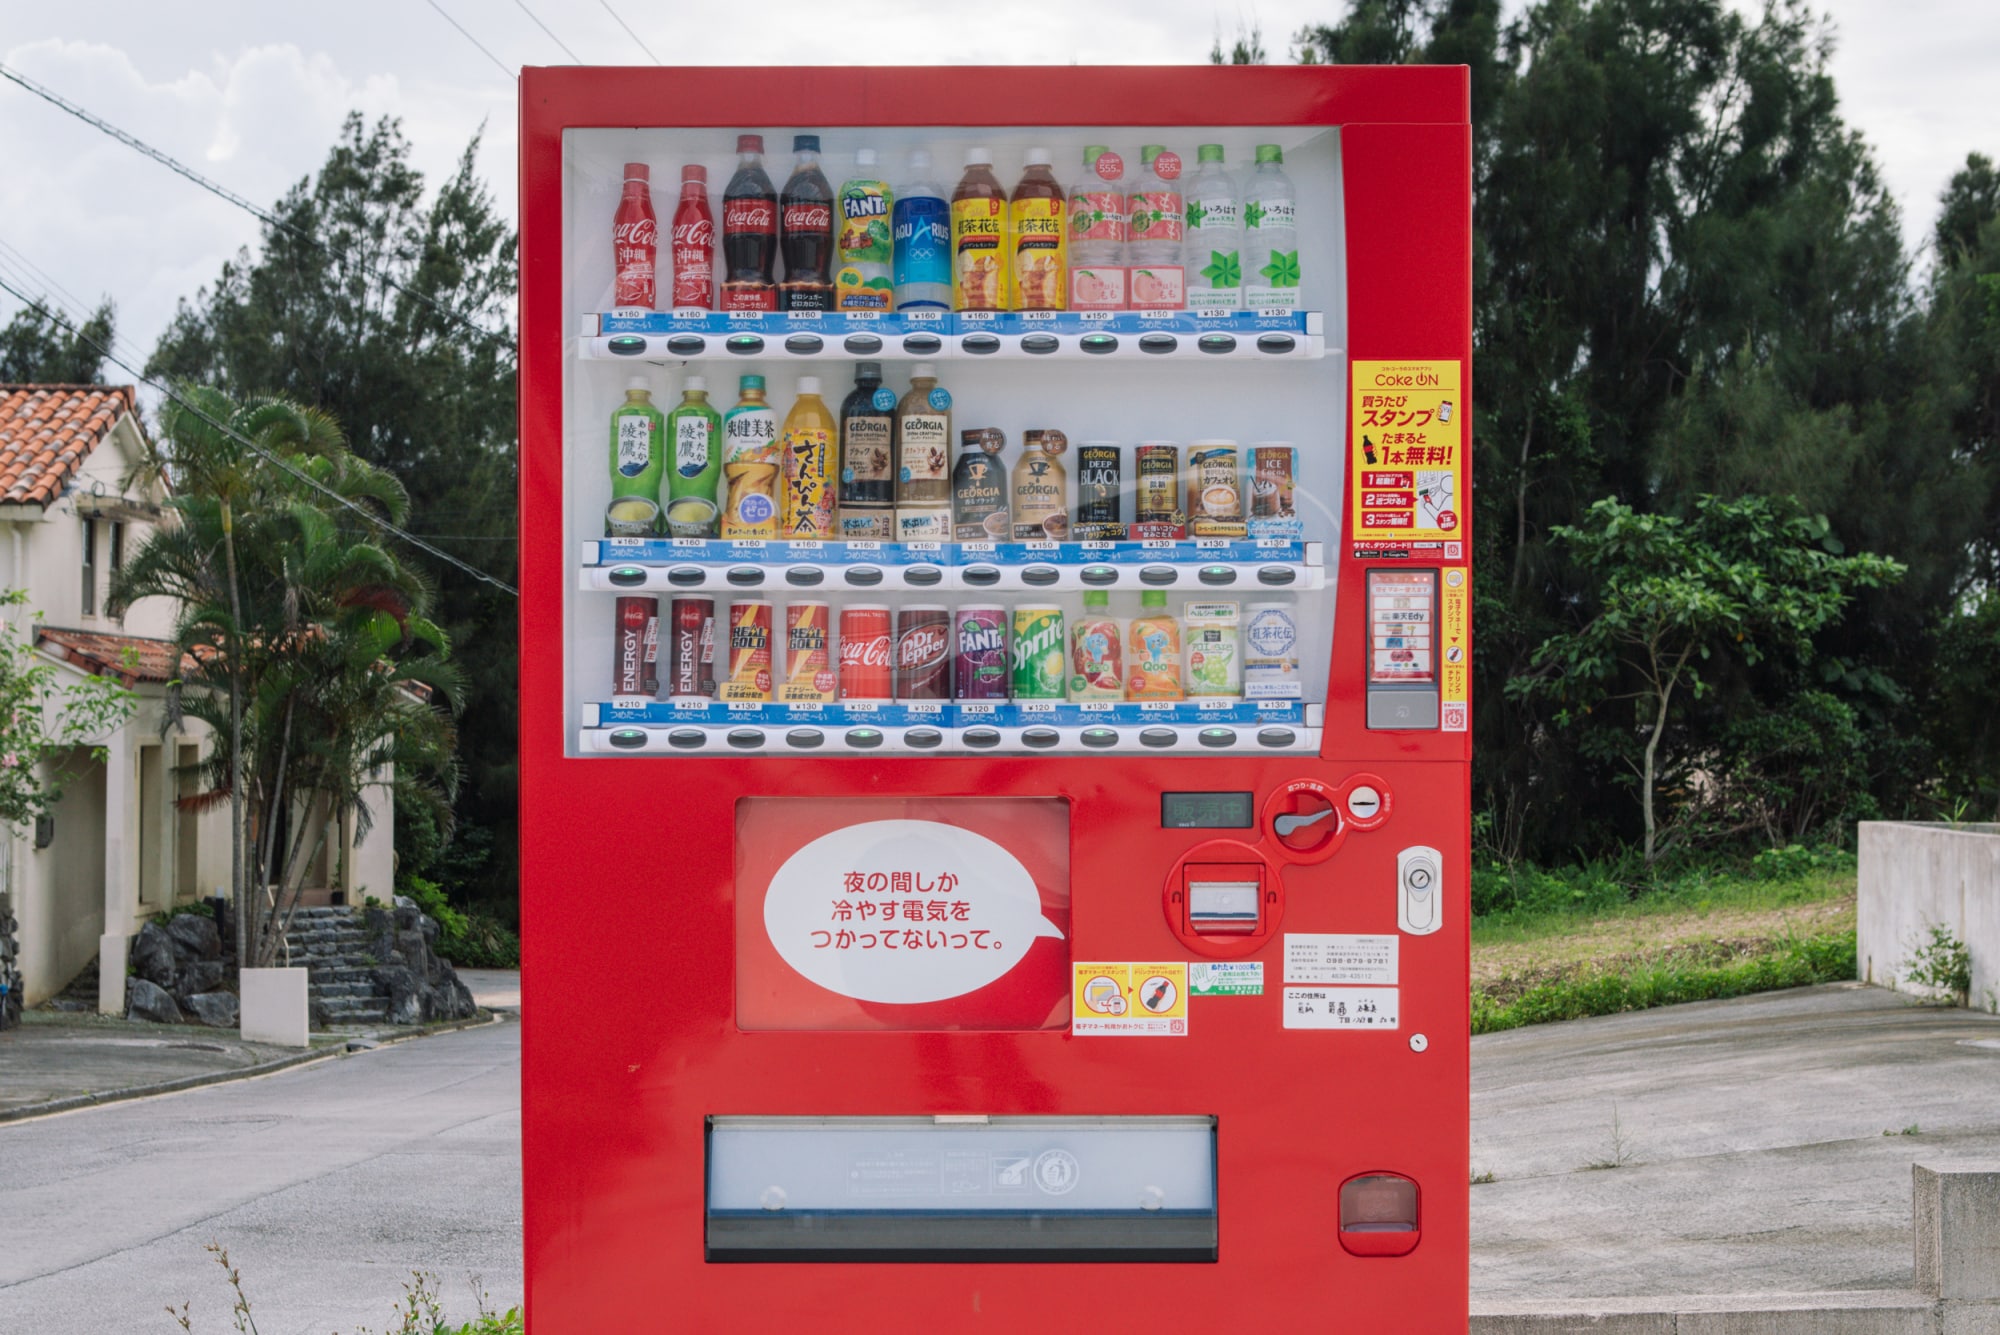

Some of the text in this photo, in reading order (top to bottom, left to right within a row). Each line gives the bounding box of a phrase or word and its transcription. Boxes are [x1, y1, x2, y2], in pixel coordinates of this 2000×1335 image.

[843, 194, 887, 219] FANTA
[726, 208, 770, 227] Coca-Cola
[784, 208, 830, 227] Coca-Cola
[895, 216, 949, 244] AQUARIUS
[619, 248, 646, 262] 沖縄
[676, 248, 704, 262] 沖縄
[1375, 372, 1439, 386] Coke ON
[1362, 396, 1407, 408] 買うたび
[905, 418, 944, 430] GEORGIA
[1361, 408, 1435, 427] スタンプ
[728, 418, 775, 439] 爽健美茶
[850, 420, 888, 432] GEORGIA
[620, 422, 637, 458] 綾鷹
[638, 418, 648, 461] あやたか
[678, 423, 696, 458] 綾鷹
[697, 418, 706, 461] あやたか
[1381, 433, 1426, 444] たまると
[1083, 449, 1116, 460] GEORGIA
[1258, 450, 1288, 460] GEORGIA
[1381, 446, 1453, 465] 1本無料!
[1088, 460, 1112, 468] DEEP
[1142, 459, 1172, 469] GEORGIA
[1203, 460, 1234, 469] GEORGIA
[1266, 459, 1282, 468] ICE
[1080, 469, 1120, 486] BLACK
[1203, 476, 1235, 485] カフェオレ
[1368, 474, 1374, 485] 1
[793, 440, 817, 534] さんぴん茶
[957, 486, 1000, 498] GEORGIA
[1017, 482, 1059, 495] GEORGIA
[1366, 494, 1375, 505] 2
[744, 506, 768, 518] ゼロ
[1366, 514, 1375, 525] 3
[733, 623, 767, 638] REAL
[790, 624, 824, 638] REAL
[914, 631, 934, 644] Dr
[1253, 627, 1293, 640] 紅茶花伝
[732, 638, 766, 649] GOLD
[788, 638, 824, 650] GOLD
[958, 628, 1003, 653] FANTA
[1013, 618, 1063, 671] Sprite
[902, 639, 945, 665] Pepper
[623, 629, 636, 692] ENERGY
[680, 630, 693, 693] ENERGY
[1142, 661, 1167, 671] Qoo
[1172, 800, 1243, 822] 販売中
[843, 871, 959, 893] 夜の間しか
[831, 900, 970, 922] 冷やす電気を
[810, 929, 1002, 950] つかってないって。
